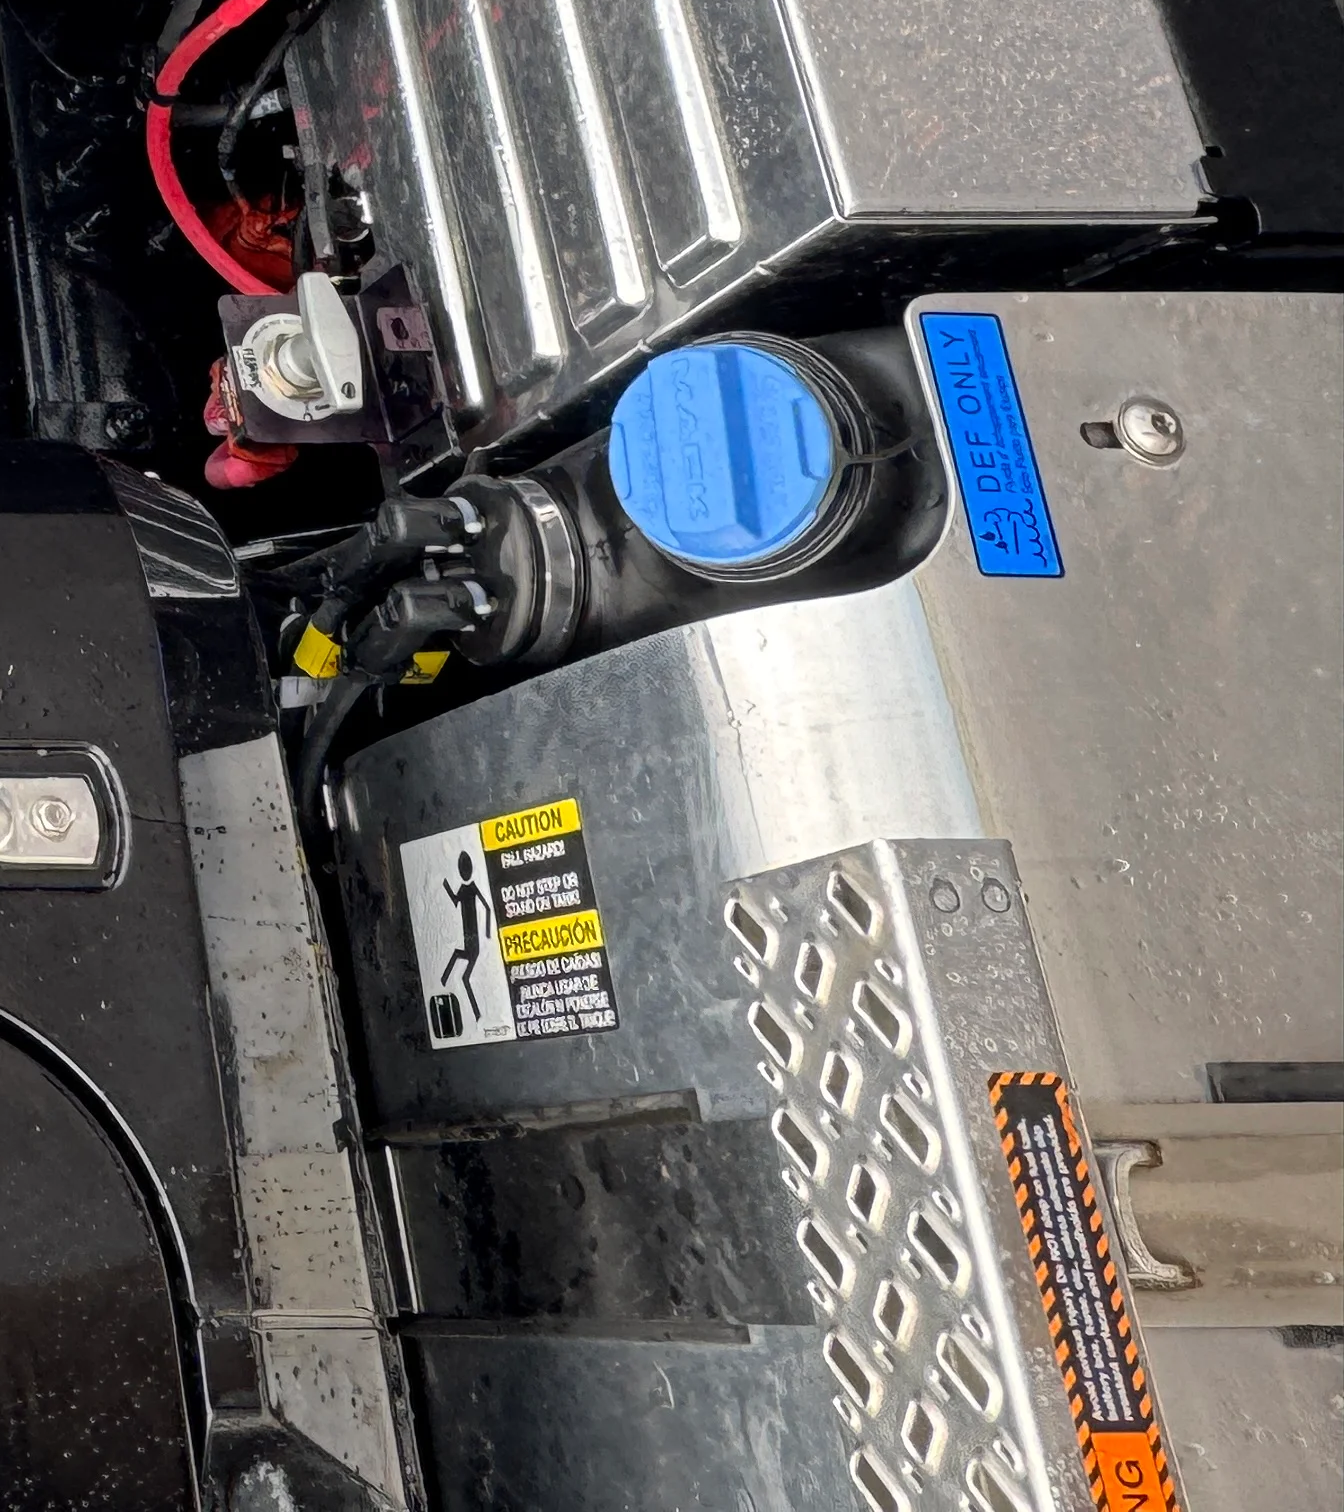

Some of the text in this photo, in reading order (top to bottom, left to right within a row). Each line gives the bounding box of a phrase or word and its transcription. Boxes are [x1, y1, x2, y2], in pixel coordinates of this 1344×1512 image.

[939, 330, 981, 415] ONLY
[964, 430, 1002, 493] DEF
[495, 807, 563, 843] CAUTION
[504, 918, 598, 957] PRECAUCIÓN
